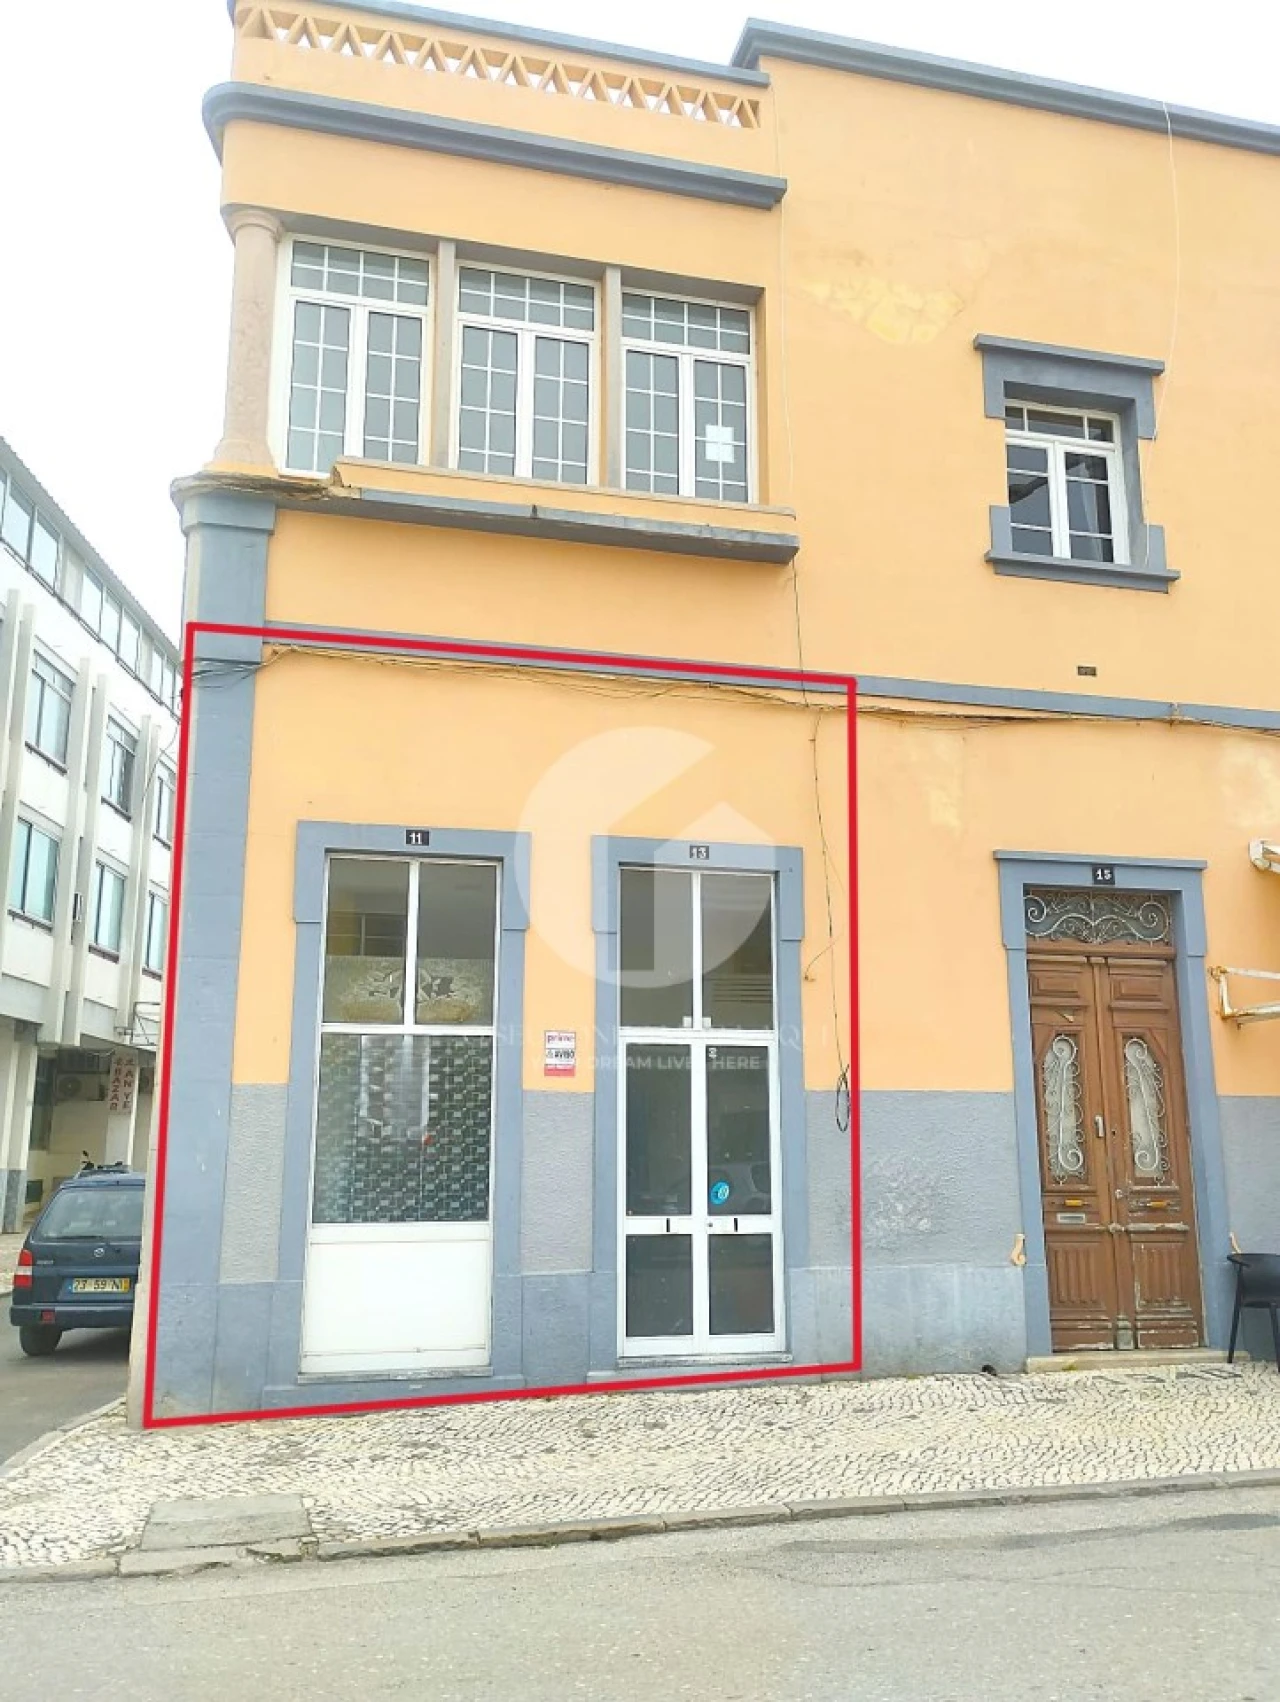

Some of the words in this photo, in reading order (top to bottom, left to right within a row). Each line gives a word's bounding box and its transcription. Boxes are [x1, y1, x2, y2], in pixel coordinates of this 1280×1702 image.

[409, 832, 423, 845] 11
[692, 846, 707, 859] 13
[1096, 868, 1113, 880] 15
